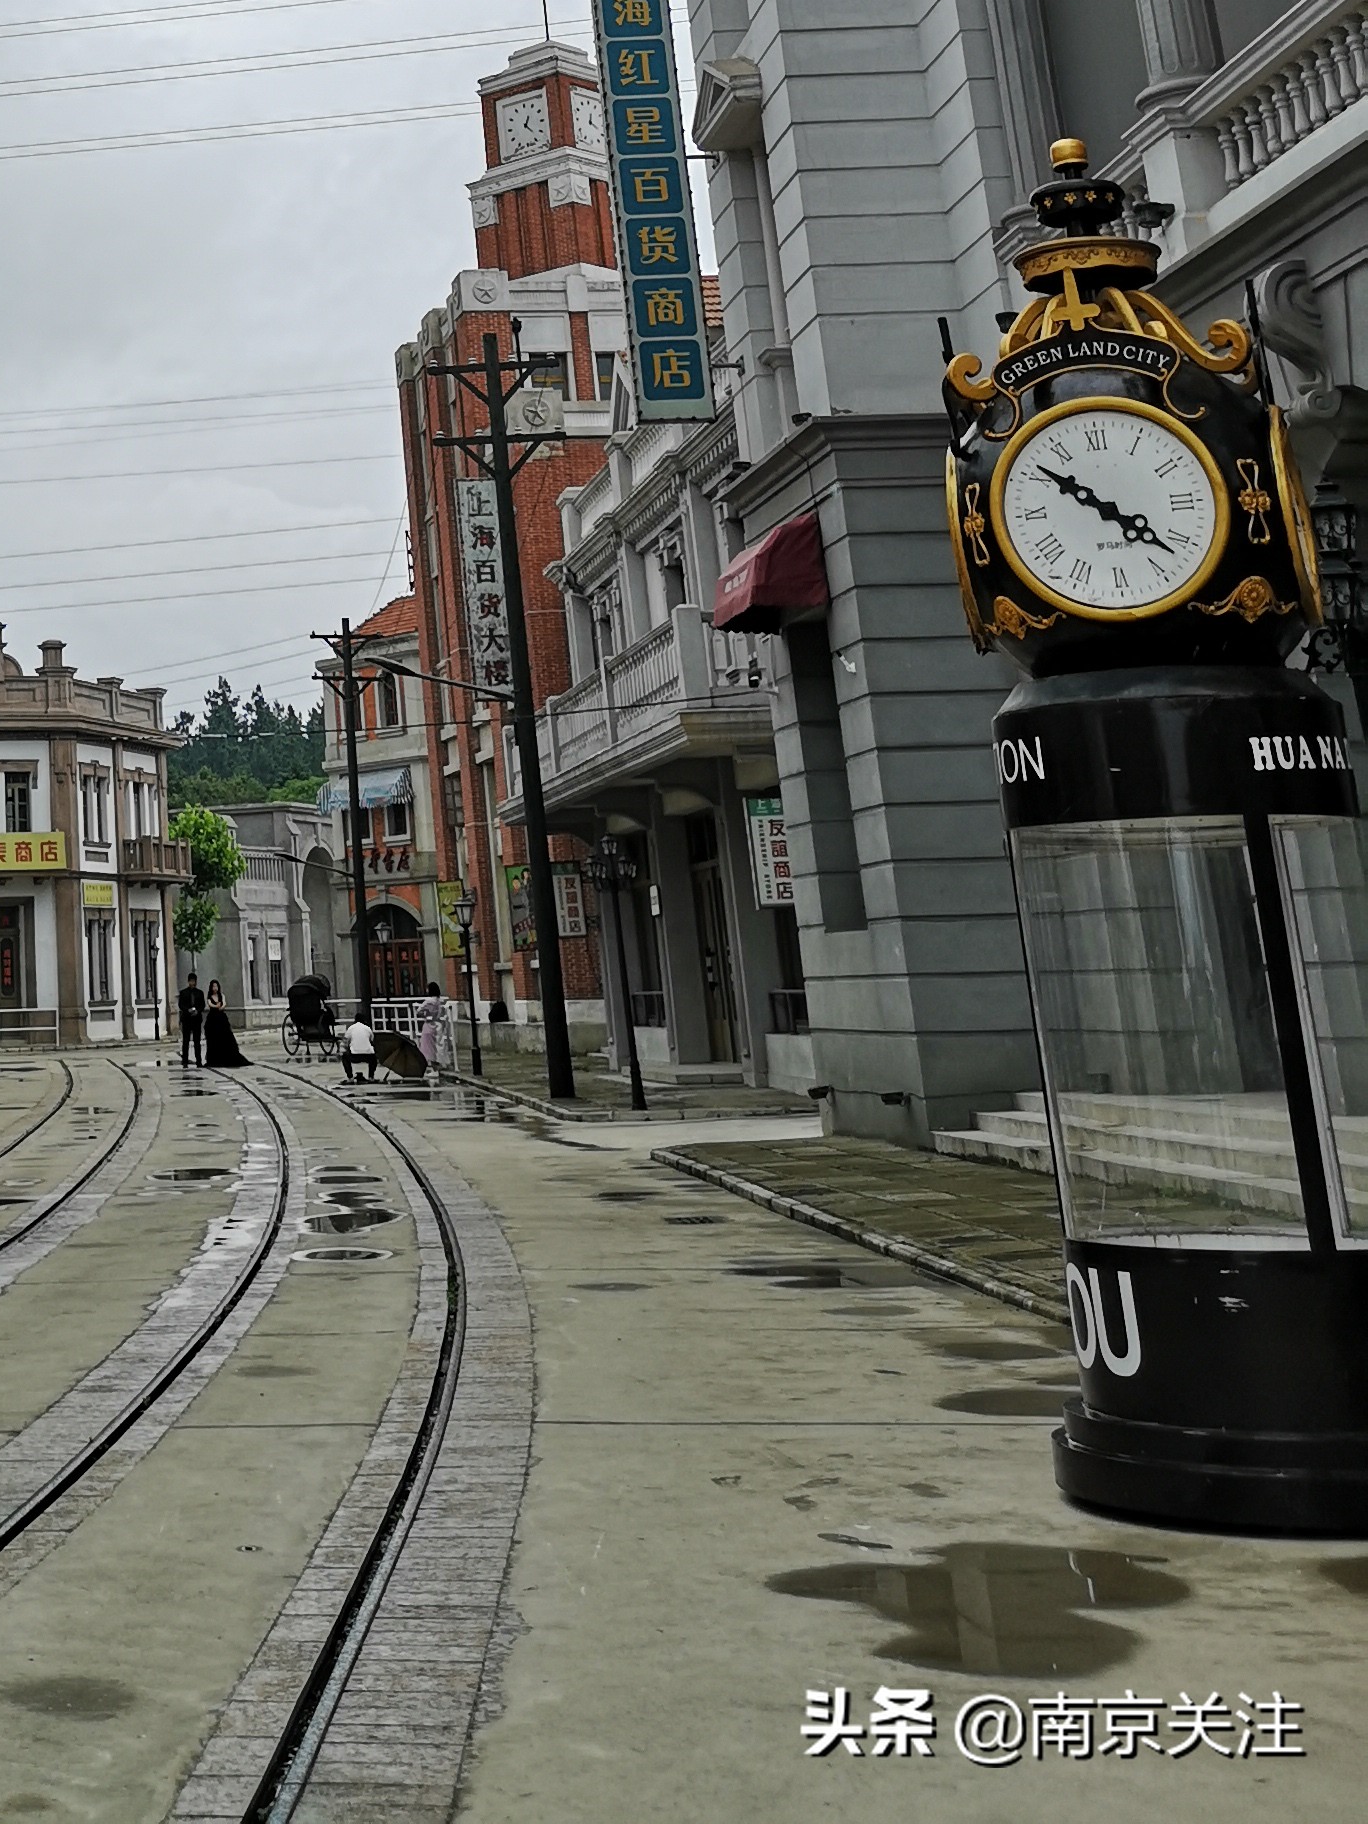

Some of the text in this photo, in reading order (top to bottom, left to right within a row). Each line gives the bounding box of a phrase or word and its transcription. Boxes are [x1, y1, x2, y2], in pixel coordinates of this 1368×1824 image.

[1001, 346, 1063, 384] GREEN
[468, 488, 509, 687] 上海百货大楼
[993, 736, 1045, 784] ION
